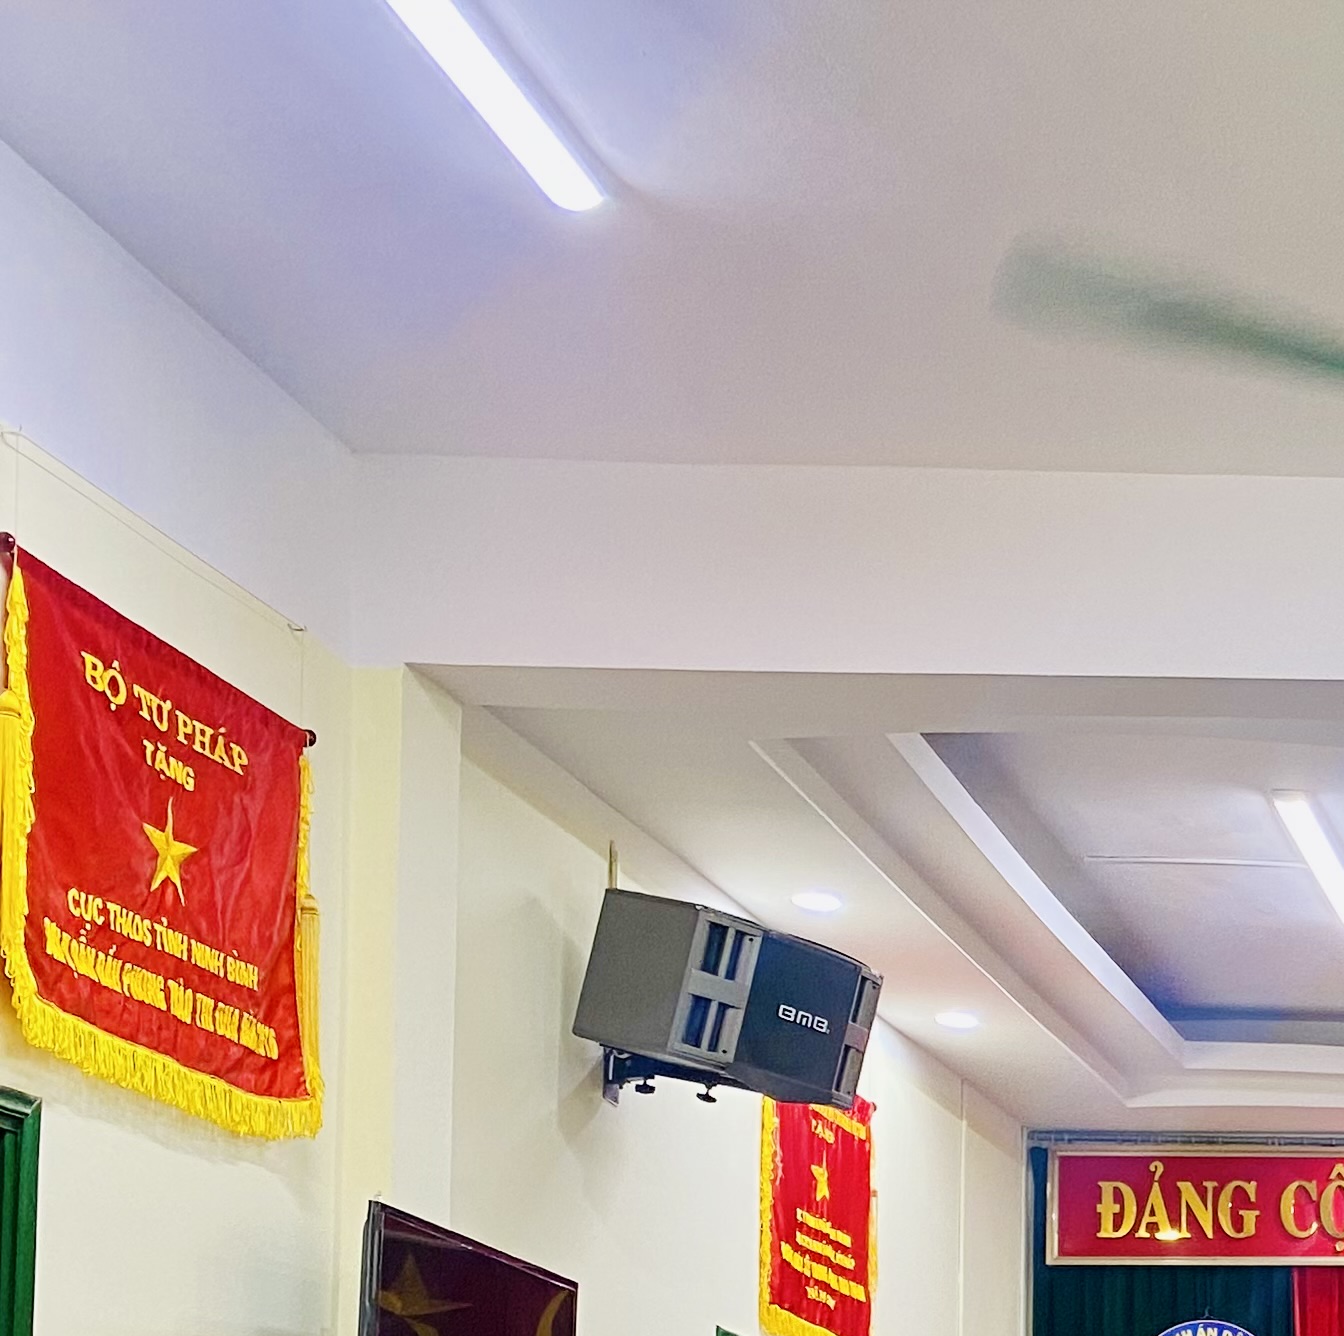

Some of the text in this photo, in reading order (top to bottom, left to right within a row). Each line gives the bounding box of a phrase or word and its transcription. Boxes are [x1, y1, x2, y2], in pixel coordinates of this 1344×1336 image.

[81, 651, 248, 776] BỘ TƯ PHÁP
[143, 739, 195, 791] TẶNG
[67, 888, 105, 931] CỤC
[1097, 1161, 1260, 1241] ĐẢNG
